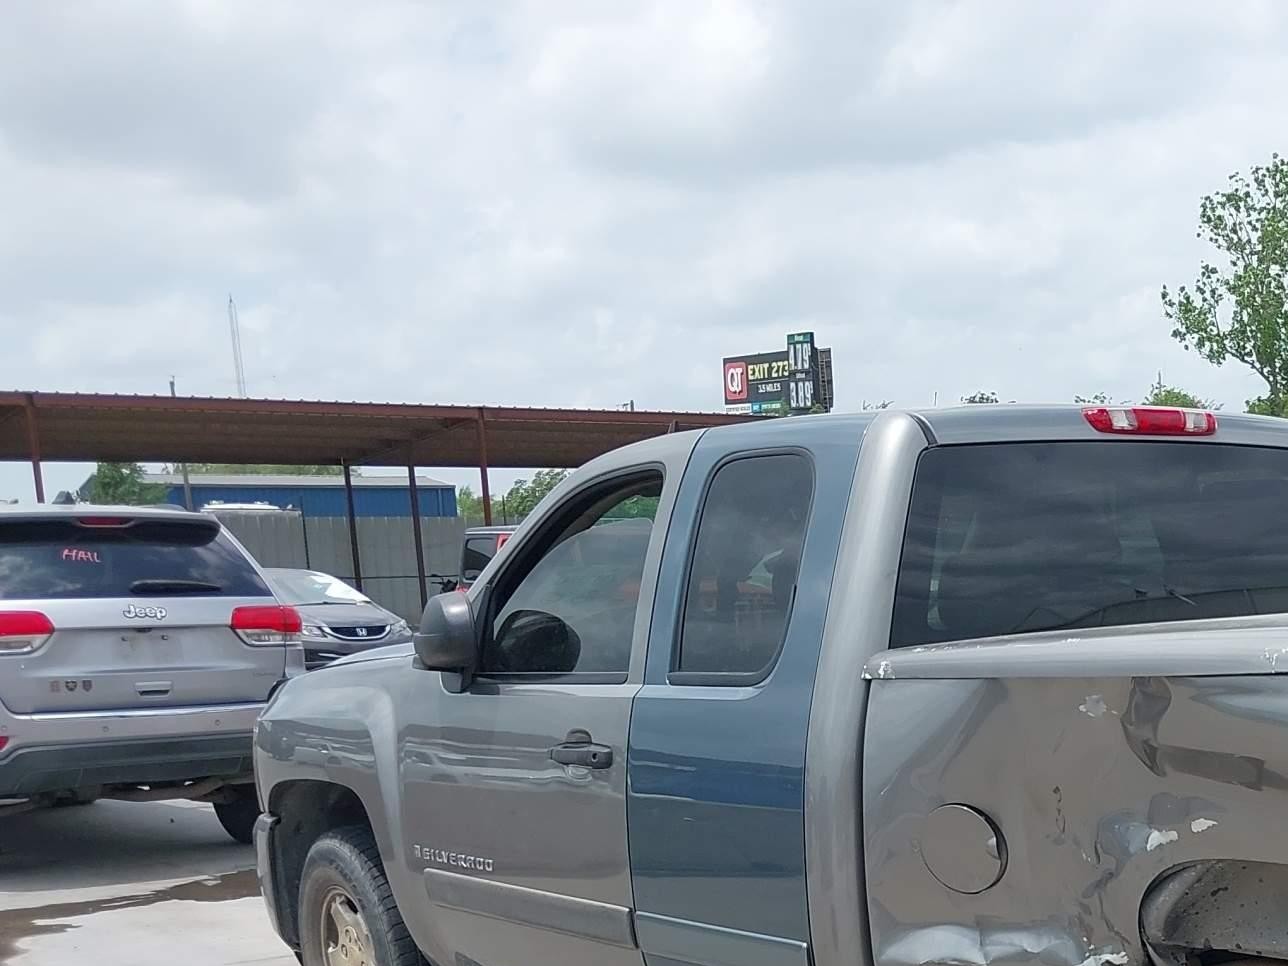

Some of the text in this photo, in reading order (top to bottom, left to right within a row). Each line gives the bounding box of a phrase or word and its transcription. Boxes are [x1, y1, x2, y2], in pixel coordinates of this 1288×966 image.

[748, 363, 769, 380] EXIT
[771, 361, 789, 378] 273
[727, 368, 742, 395] QT
[766, 381, 781, 392] MILES
[123, 604, 167, 620] Jeep
[423, 847, 494, 872] SILVERADO
